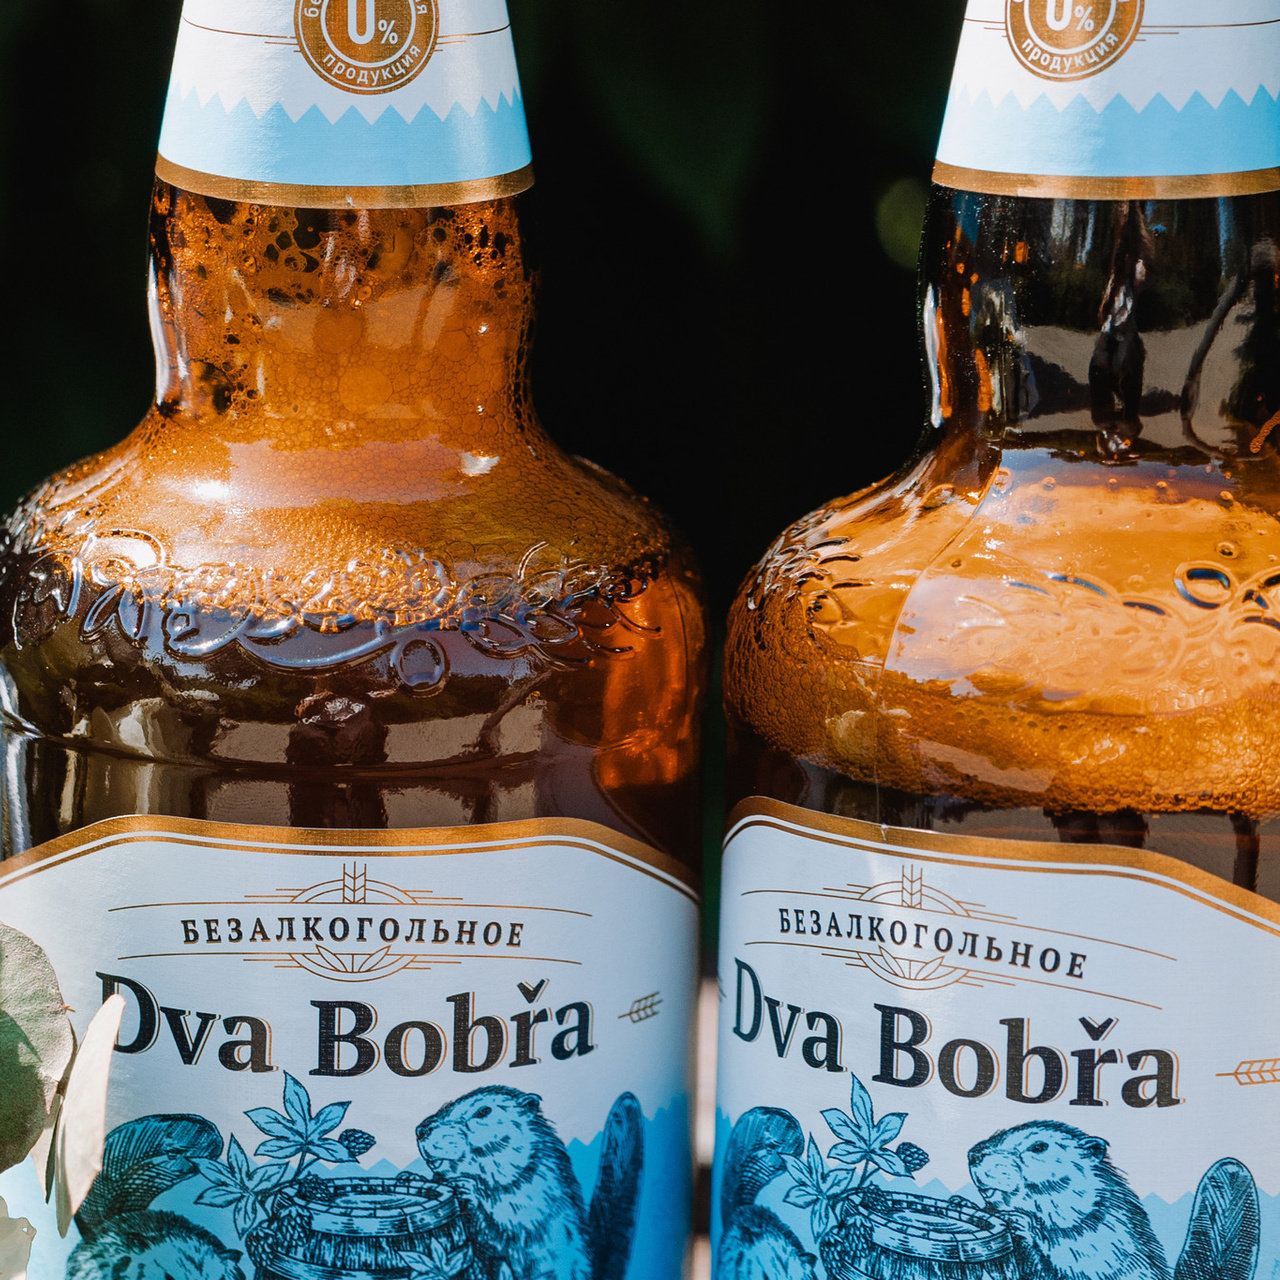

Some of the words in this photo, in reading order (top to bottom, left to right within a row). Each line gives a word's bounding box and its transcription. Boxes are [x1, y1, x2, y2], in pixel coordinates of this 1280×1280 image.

[322, 44, 421, 86] продукция
[1021, 31, 1119, 73] продукция
[180, 916, 525, 947] БЕЗАЛКОГОЛЬНОЕ
[778, 907, 1088, 980] БЕЗАЛКОГОЛЬНОЕ
[95, 970, 279, 1072] Dva
[308, 977, 599, 1078] Bobřa
[733, 956, 848, 1074] Dva
[872, 1001, 1186, 1109] Bobřa
